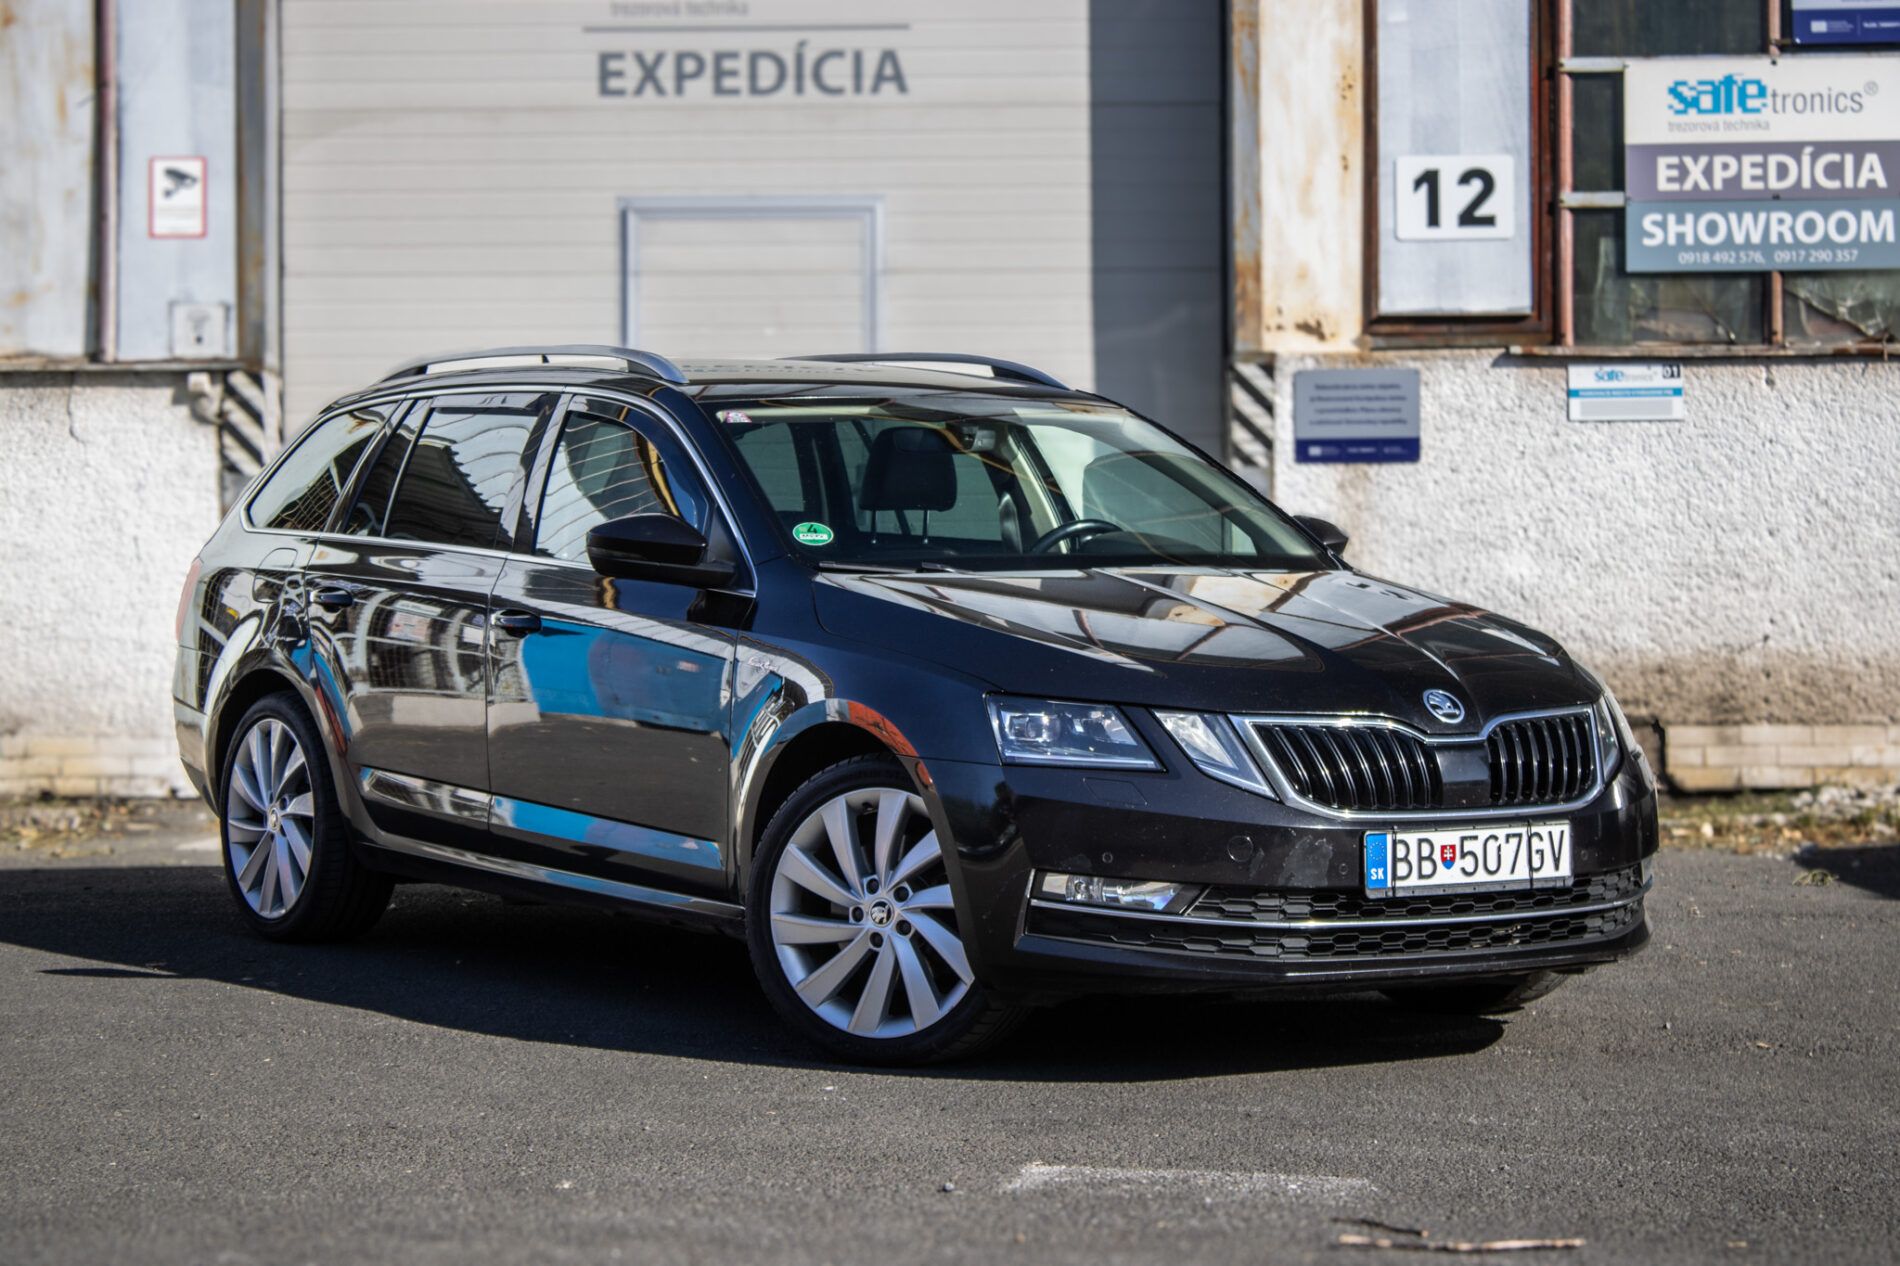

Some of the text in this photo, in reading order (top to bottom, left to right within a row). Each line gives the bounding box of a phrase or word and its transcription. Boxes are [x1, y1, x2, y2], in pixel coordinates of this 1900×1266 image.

[598, 39, 909, 97] EXPEDÍCIA
[1656, 146, 1888, 192] EXPEDÍCIA
[1413, 166, 1496, 228] 12
[1641, 209, 1895, 247] SHOWROOM
[1678, 251, 1710, 264] 0918
[1713, 251, 1736, 264] 492
[1774, 250, 1804, 263] 0917
[1808, 250, 1832, 263] 290
[1836, 249, 1859, 262] 357
[1370, 867, 1385, 880] SK
[1394, 829, 1565, 880] BB 507GV
